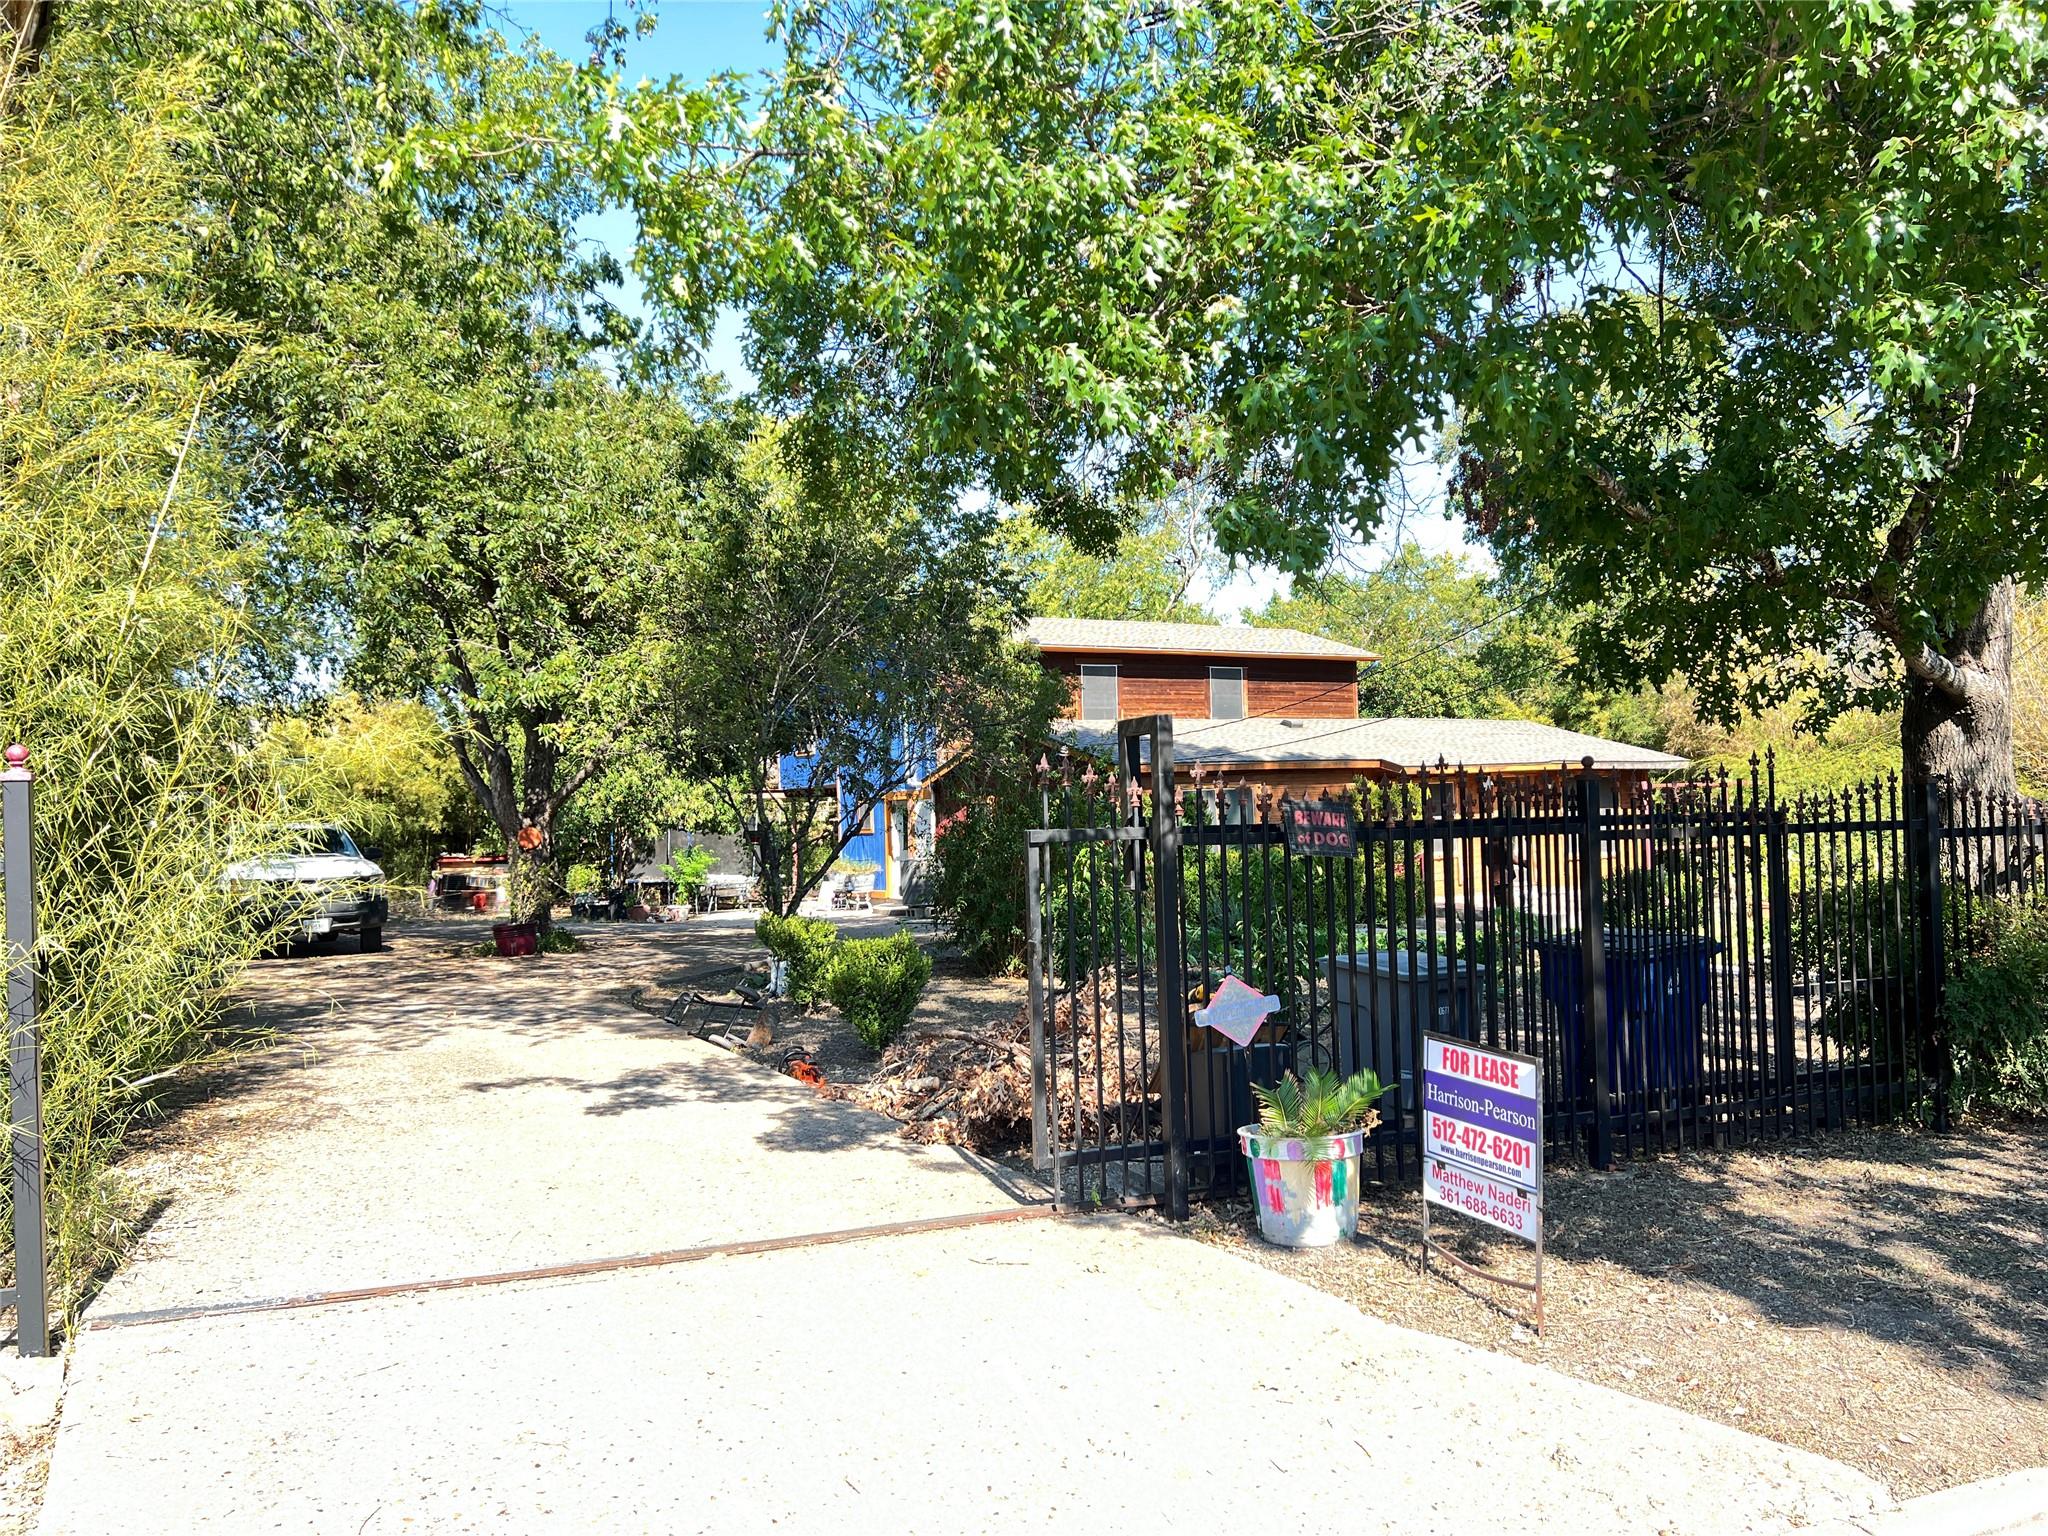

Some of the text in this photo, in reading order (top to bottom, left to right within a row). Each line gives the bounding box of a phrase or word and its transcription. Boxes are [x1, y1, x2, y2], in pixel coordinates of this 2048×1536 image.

[1294, 810, 1346, 828] BEWARE
[1297, 831, 1350, 848] of DOG
[1442, 1046, 1519, 1090] FOR LEASE
[1427, 1082, 1536, 1130] Harrison-Pearson
[1432, 1116, 1531, 1169] 512-472-6201
[1440, 1143, 1522, 1178] www.harrisonpearson.com
[1432, 1163, 1531, 1213] Matthew Naderi
[1440, 1185, 1523, 1230] 361-688-6633
